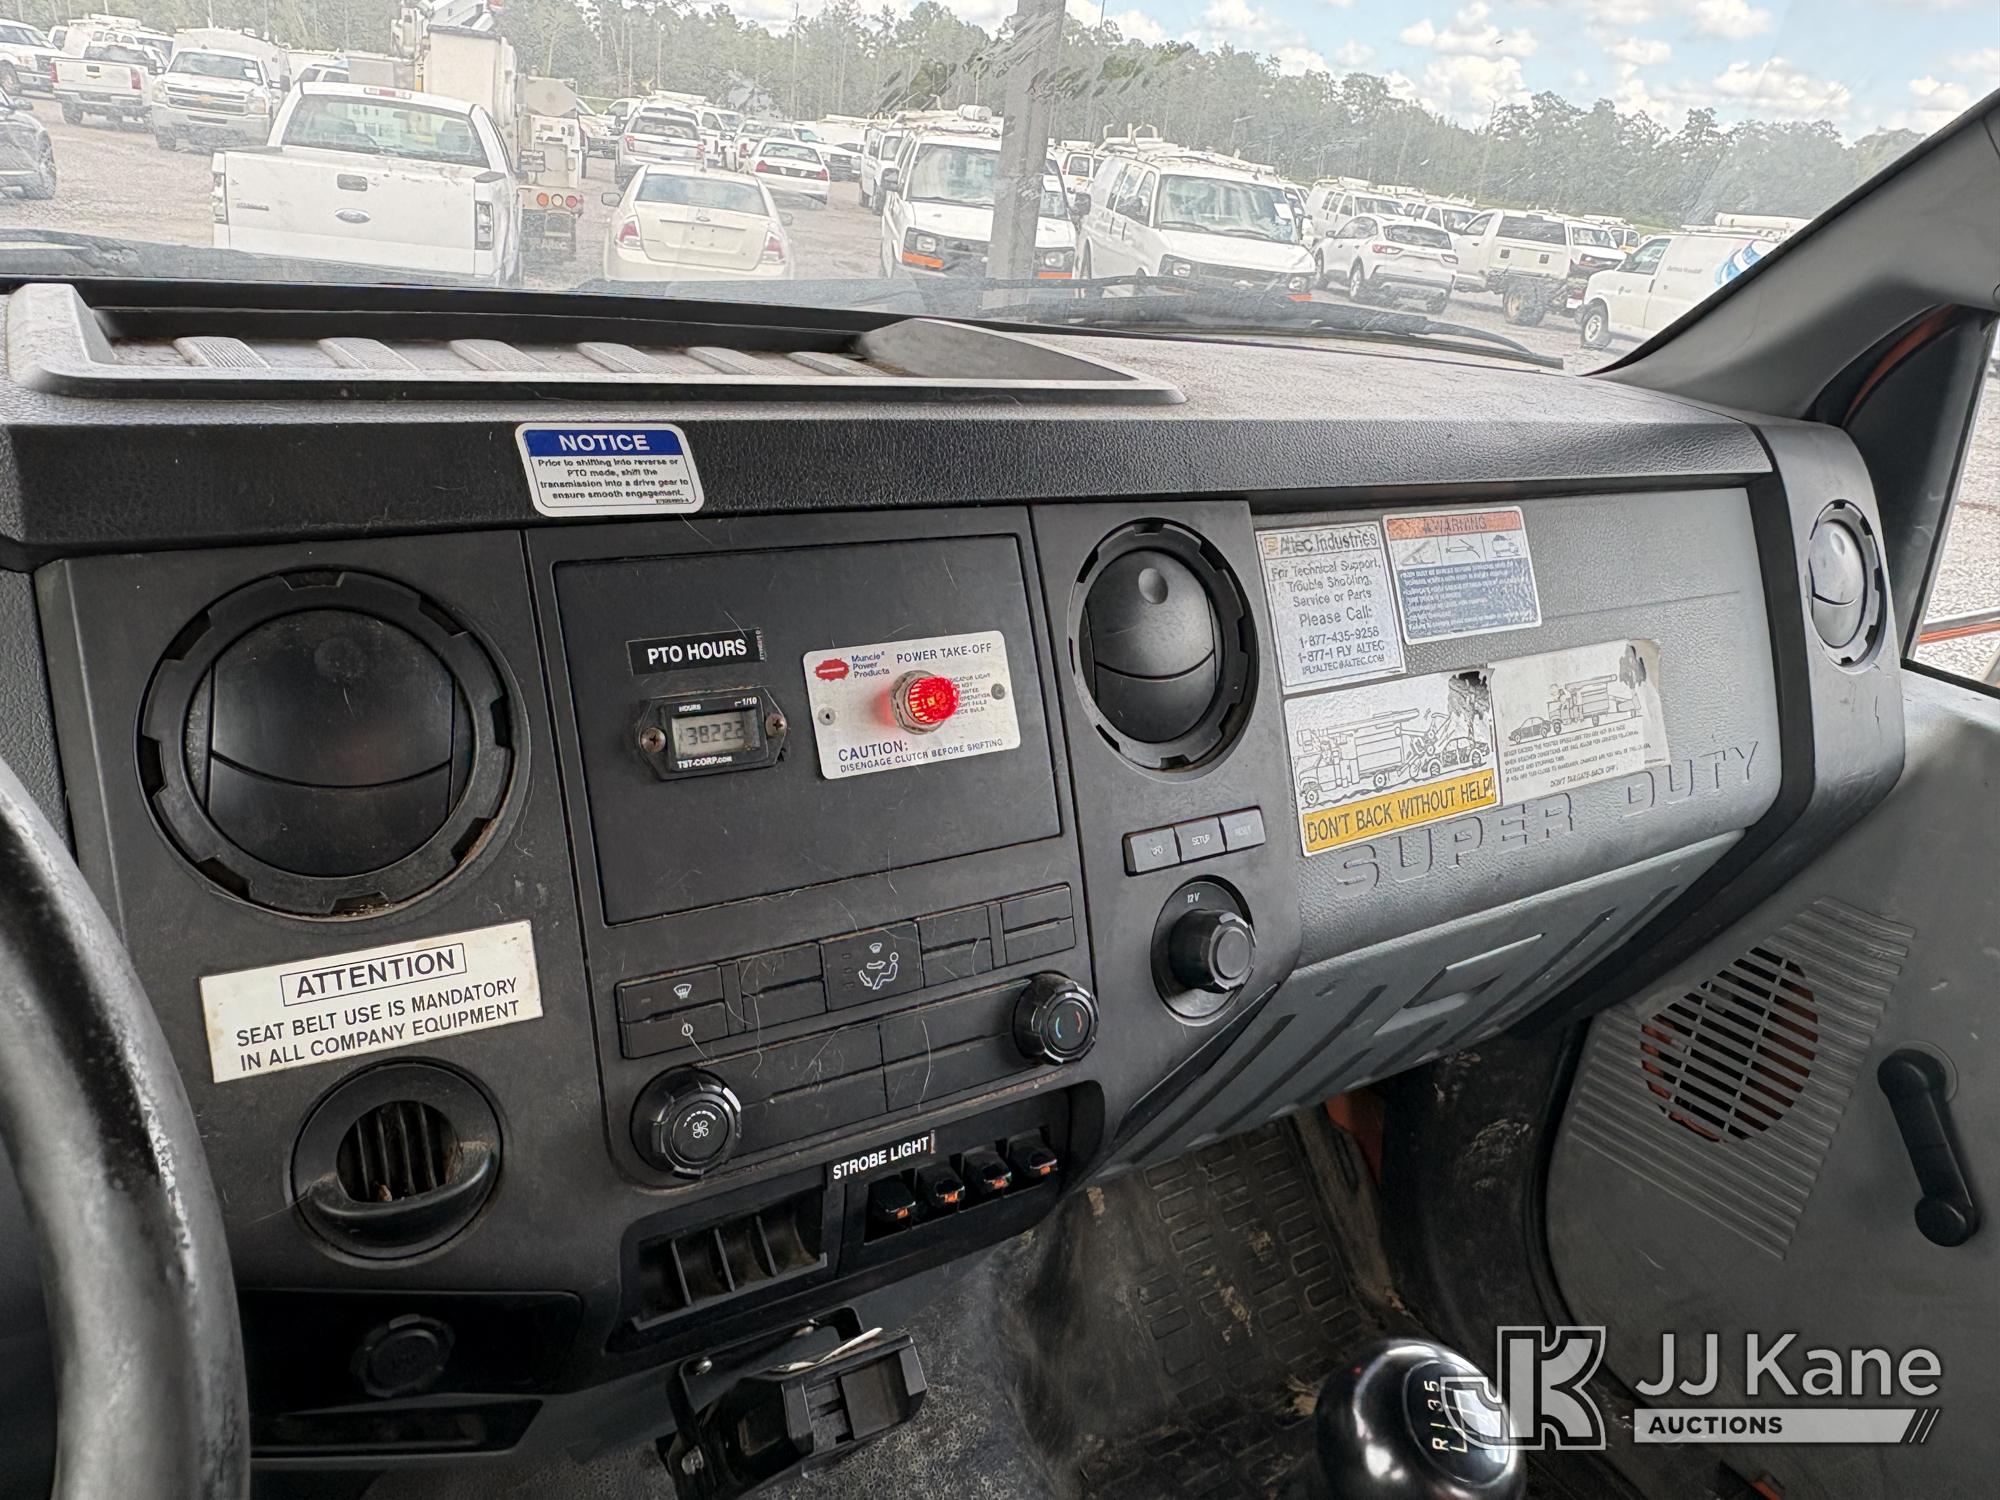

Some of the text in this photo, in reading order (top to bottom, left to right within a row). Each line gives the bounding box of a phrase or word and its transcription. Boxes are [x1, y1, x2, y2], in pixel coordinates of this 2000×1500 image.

[558, 434, 650, 452] NOTICE
[538, 459, 561, 467] Prior
[564, 459, 574, 467] to
[576, 458, 612, 468] shifting
[614, 458, 632, 466] into
[566, 468, 658, 477] PTO mode, shift the
[540, 479, 603, 489] transmission
[633, 479, 656, 487] drive
[658, 480, 678, 488] gear
[679, 478, 689, 486] to
[552, 489, 684, 500] ensure smooth engagement.
[1280, 529, 1377, 555] Altec Industries
[1271, 566, 1288, 580] For
[1293, 560, 1337, 577] Technical
[1286, 577, 1324, 593] Trouble
[1293, 588, 1372, 608] Service or Parts
[1299, 605, 1373, 627] Please Call:
[1299, 625, 1379, 648] 1-877-435-9258
[647, 645, 683, 665] PTO
[686, 638, 747, 661] HOURS
[896, 642, 992, 664] POWER TAKE-OFF
[1336, 644, 1353, 659] FLY
[1356, 639, 1385, 653] ALTEC
[852, 661, 878, 671] Power
[853, 668, 890, 679] Products
[838, 740, 909, 762] CAUTION:
[840, 738, 1003, 773] DISENGAGE CLUTCH BEFORE SHIFTING
[1306, 812, 1351, 845] DON'T
[1356, 801, 1394, 832] BACK
[1397, 786, 1457, 821] WITHOUT
[1335, 792, 1574, 898] SUPER
[1623, 740, 1760, 818] DUTY
[1191, 833, 1211, 846] SETUP
[296, 948, 455, 999] ATTENTION
[236, 976, 518, 1048] SEAT BELT USE IS MANDATORY
[240, 999, 520, 1072] IN ALL COMPANY EQUIPMENT
[832, 1136, 929, 1180] STROBE LIGHT
[1423, 1380, 1441, 1393] 5
[1427, 1399, 1444, 1413] 3
[1431, 1437, 1450, 1452] R
